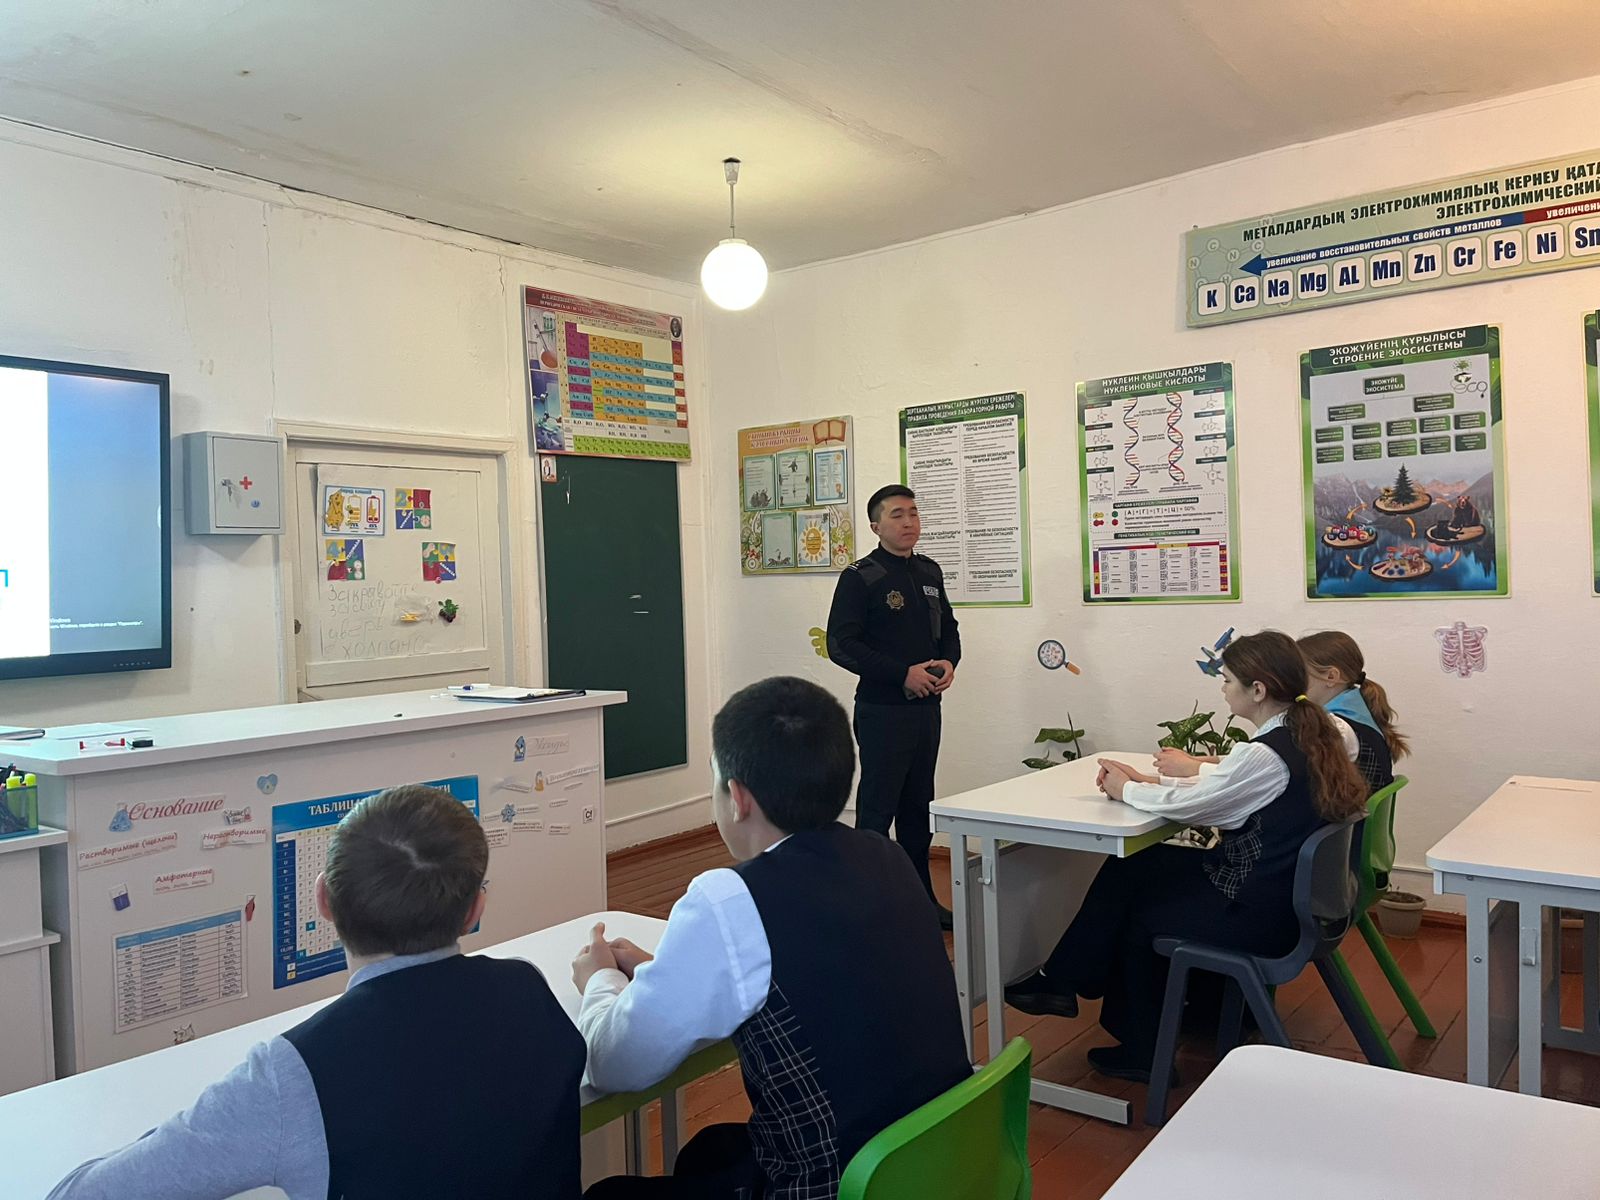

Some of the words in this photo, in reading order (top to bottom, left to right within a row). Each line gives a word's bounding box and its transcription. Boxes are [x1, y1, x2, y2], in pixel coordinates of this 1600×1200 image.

[1243, 210, 1345, 242] МЕТАЛДАРДЫҢ
[1351, 180, 1499, 220] ЭЛЕКТРОХИМИЯЛЫҚ
[1505, 169, 1560, 192] КЕРНЕУ
[1266, 251, 1317, 269] увеличение
[1320, 235, 1410, 259] восстановительных
[1413, 226, 1451, 242] свойств
[1455, 218, 1502, 234] металлов
[1207, 289, 1218, 308] K
[1234, 284, 1256, 304] Ca
[1267, 278, 1290, 298] Na
[1300, 272, 1327, 297] Mg
[1373, 259, 1401, 281] Mn
[1414, 253, 1436, 274] Zn
[1453, 246, 1476, 267] Cr
[1494, 240, 1516, 261] Fe
[1536, 232, 1557, 255] Ni
[1329, 338, 1399, 357] ЭКОЖҮЙЕНІҢ
[1402, 329, 1467, 351] ҚҰРЫЛЫСЫ
[1332, 351, 1385, 366] СТРОЕНИЕ
[1388, 340, 1463, 358] ЭКОСИСТЕМЫ
[1102, 375, 1140, 387] НУКЛЕИН
[1142, 365, 1207, 384] ҚЫШҚЫЛДАРЫ
[1103, 381, 1163, 395] НУКЛЕИНОВЫЕ
[1165, 374, 1206, 387] КИСЛОТЫ
[1366, 383, 1404, 393] ЭКОСИСТЕМА
[907, 413, 928, 423] ПРАВИЛА
[958, 405, 994, 416] ЛАБОРАТОРНОЙ
[995, 401, 1015, 411] РАБОТЫ
[129, 798, 224, 821] Основание
[155, 868, 213, 884] Амфотерные
